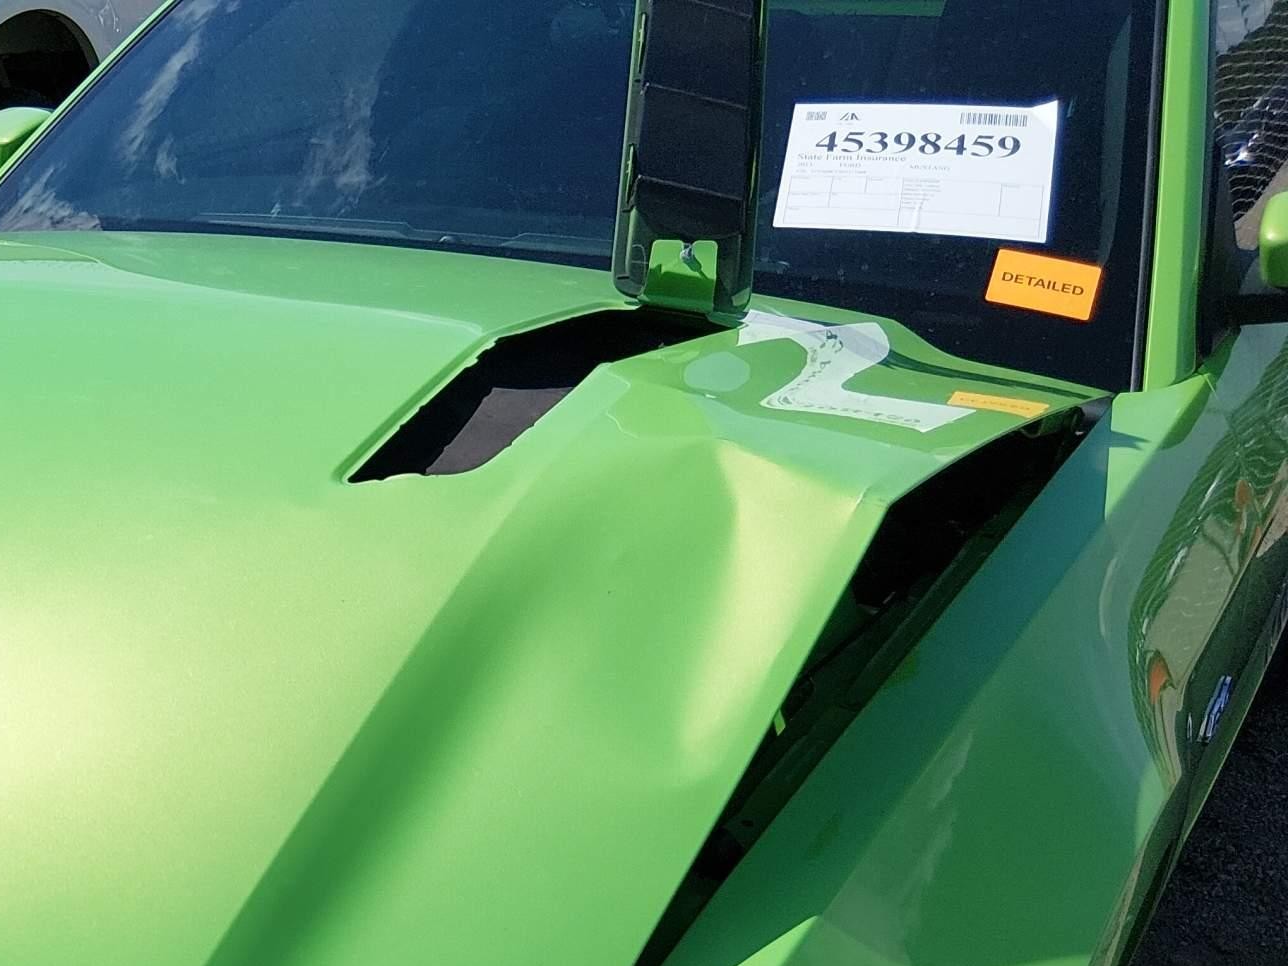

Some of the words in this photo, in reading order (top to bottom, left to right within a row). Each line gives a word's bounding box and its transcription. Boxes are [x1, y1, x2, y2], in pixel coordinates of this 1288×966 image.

[815, 130, 1021, 159] 45398459
[797, 153, 823, 161] State
[826, 153, 853, 161] Farm
[856, 153, 907, 162] Insurance
[1001, 271, 1085, 296] DETAILED
